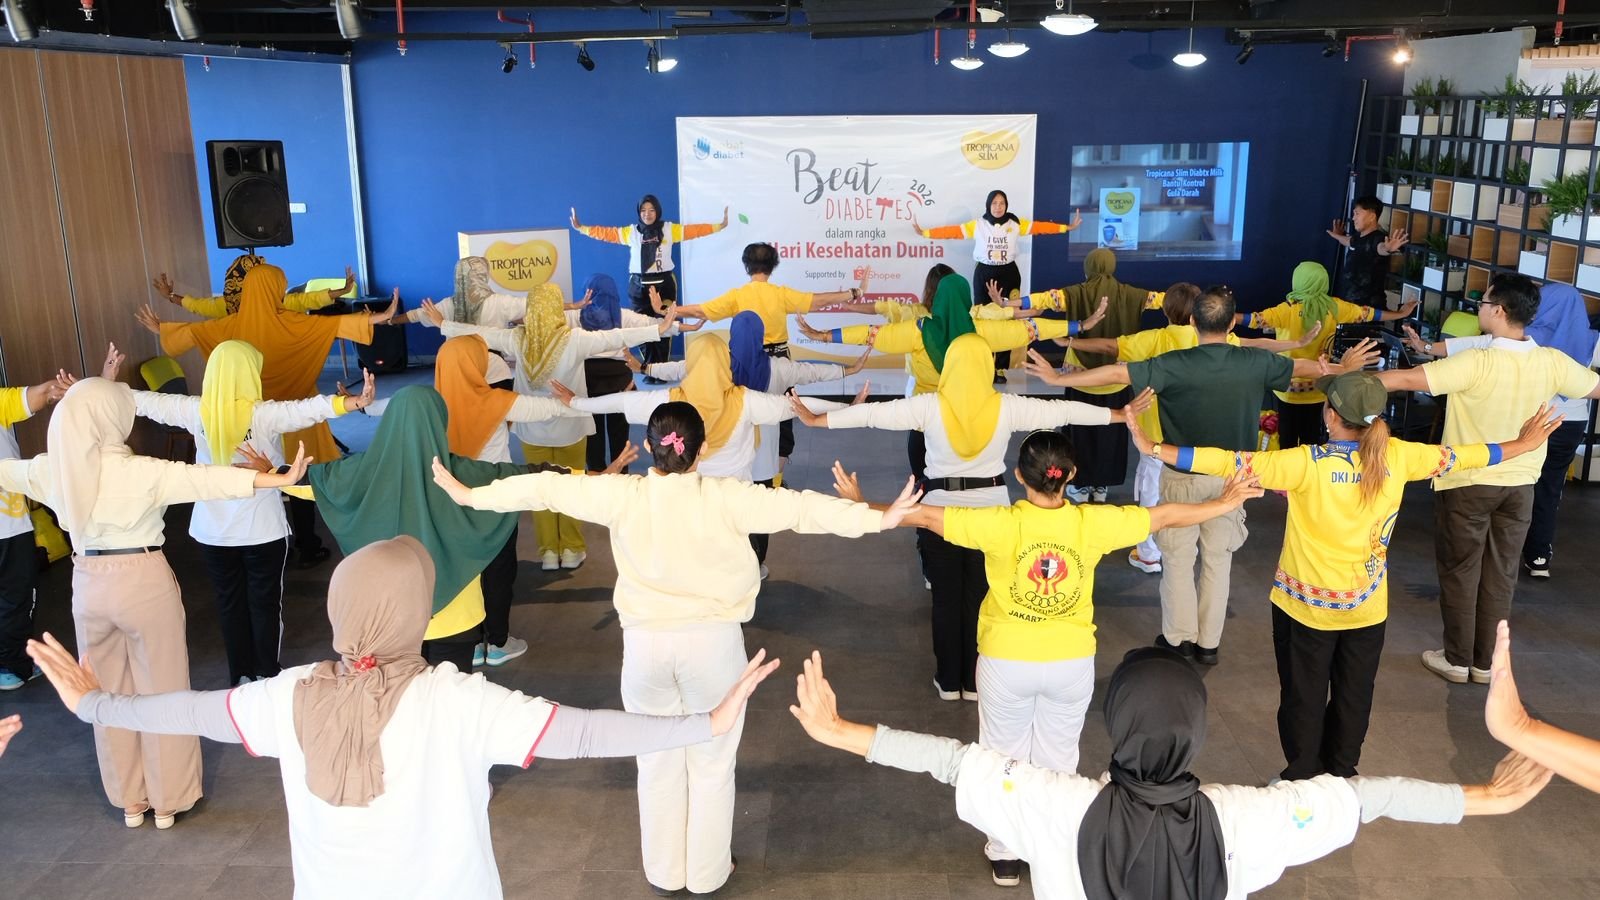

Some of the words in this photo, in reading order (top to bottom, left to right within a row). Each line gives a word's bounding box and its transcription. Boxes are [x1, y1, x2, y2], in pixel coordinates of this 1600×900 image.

[965, 143, 1015, 151] TROPICANA
[978, 151, 998, 160] SLIM
[786, 148, 881, 205] Beat
[1146, 169, 1175, 178] Tropicana
[1175, 168, 1189, 177] Slim
[1210, 167, 1224, 176] Milk
[1162, 179, 1181, 187] Bantu
[1182, 178, 1205, 187] Kontrol
[910, 179, 935, 206] 2026
[1167, 189, 1181, 197] Gula
[1181, 188, 1200, 197] Darah
[826, 197, 913, 221] DIABETES
[825, 228, 853, 239] dalam
[855, 228, 886, 241] rangka
[806, 241, 892, 258] Kesehatan
[896, 242, 944, 258] Dunia
[490, 256, 552, 270] TROPICANA
[508, 268, 533, 280] SLIM
[805, 270, 836, 280] Supported
[838, 270, 846, 280] by
[1331, 472, 1348, 483] DKI
